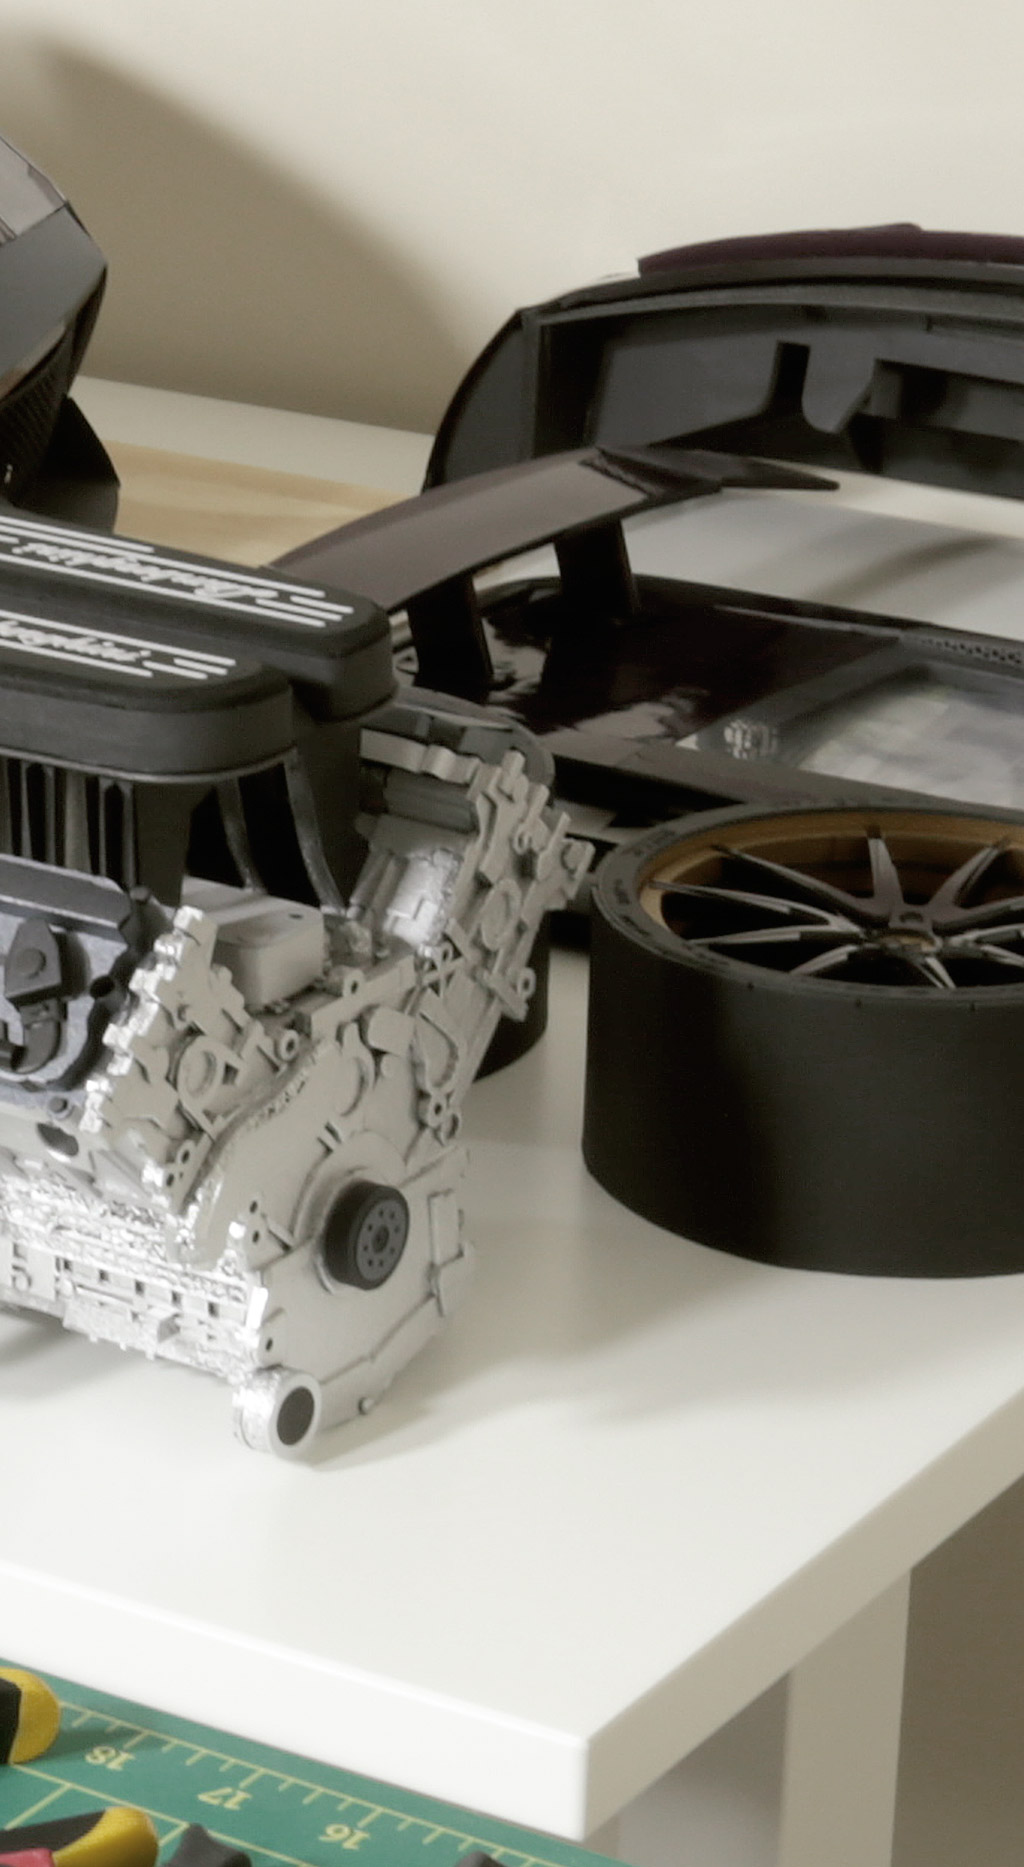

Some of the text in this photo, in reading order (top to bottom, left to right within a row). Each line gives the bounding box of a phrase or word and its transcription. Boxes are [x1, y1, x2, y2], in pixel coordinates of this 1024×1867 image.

[85, 1746, 136, 1771] 18
[197, 1787, 252, 1811] 17
[318, 1823, 370, 1850] 16
